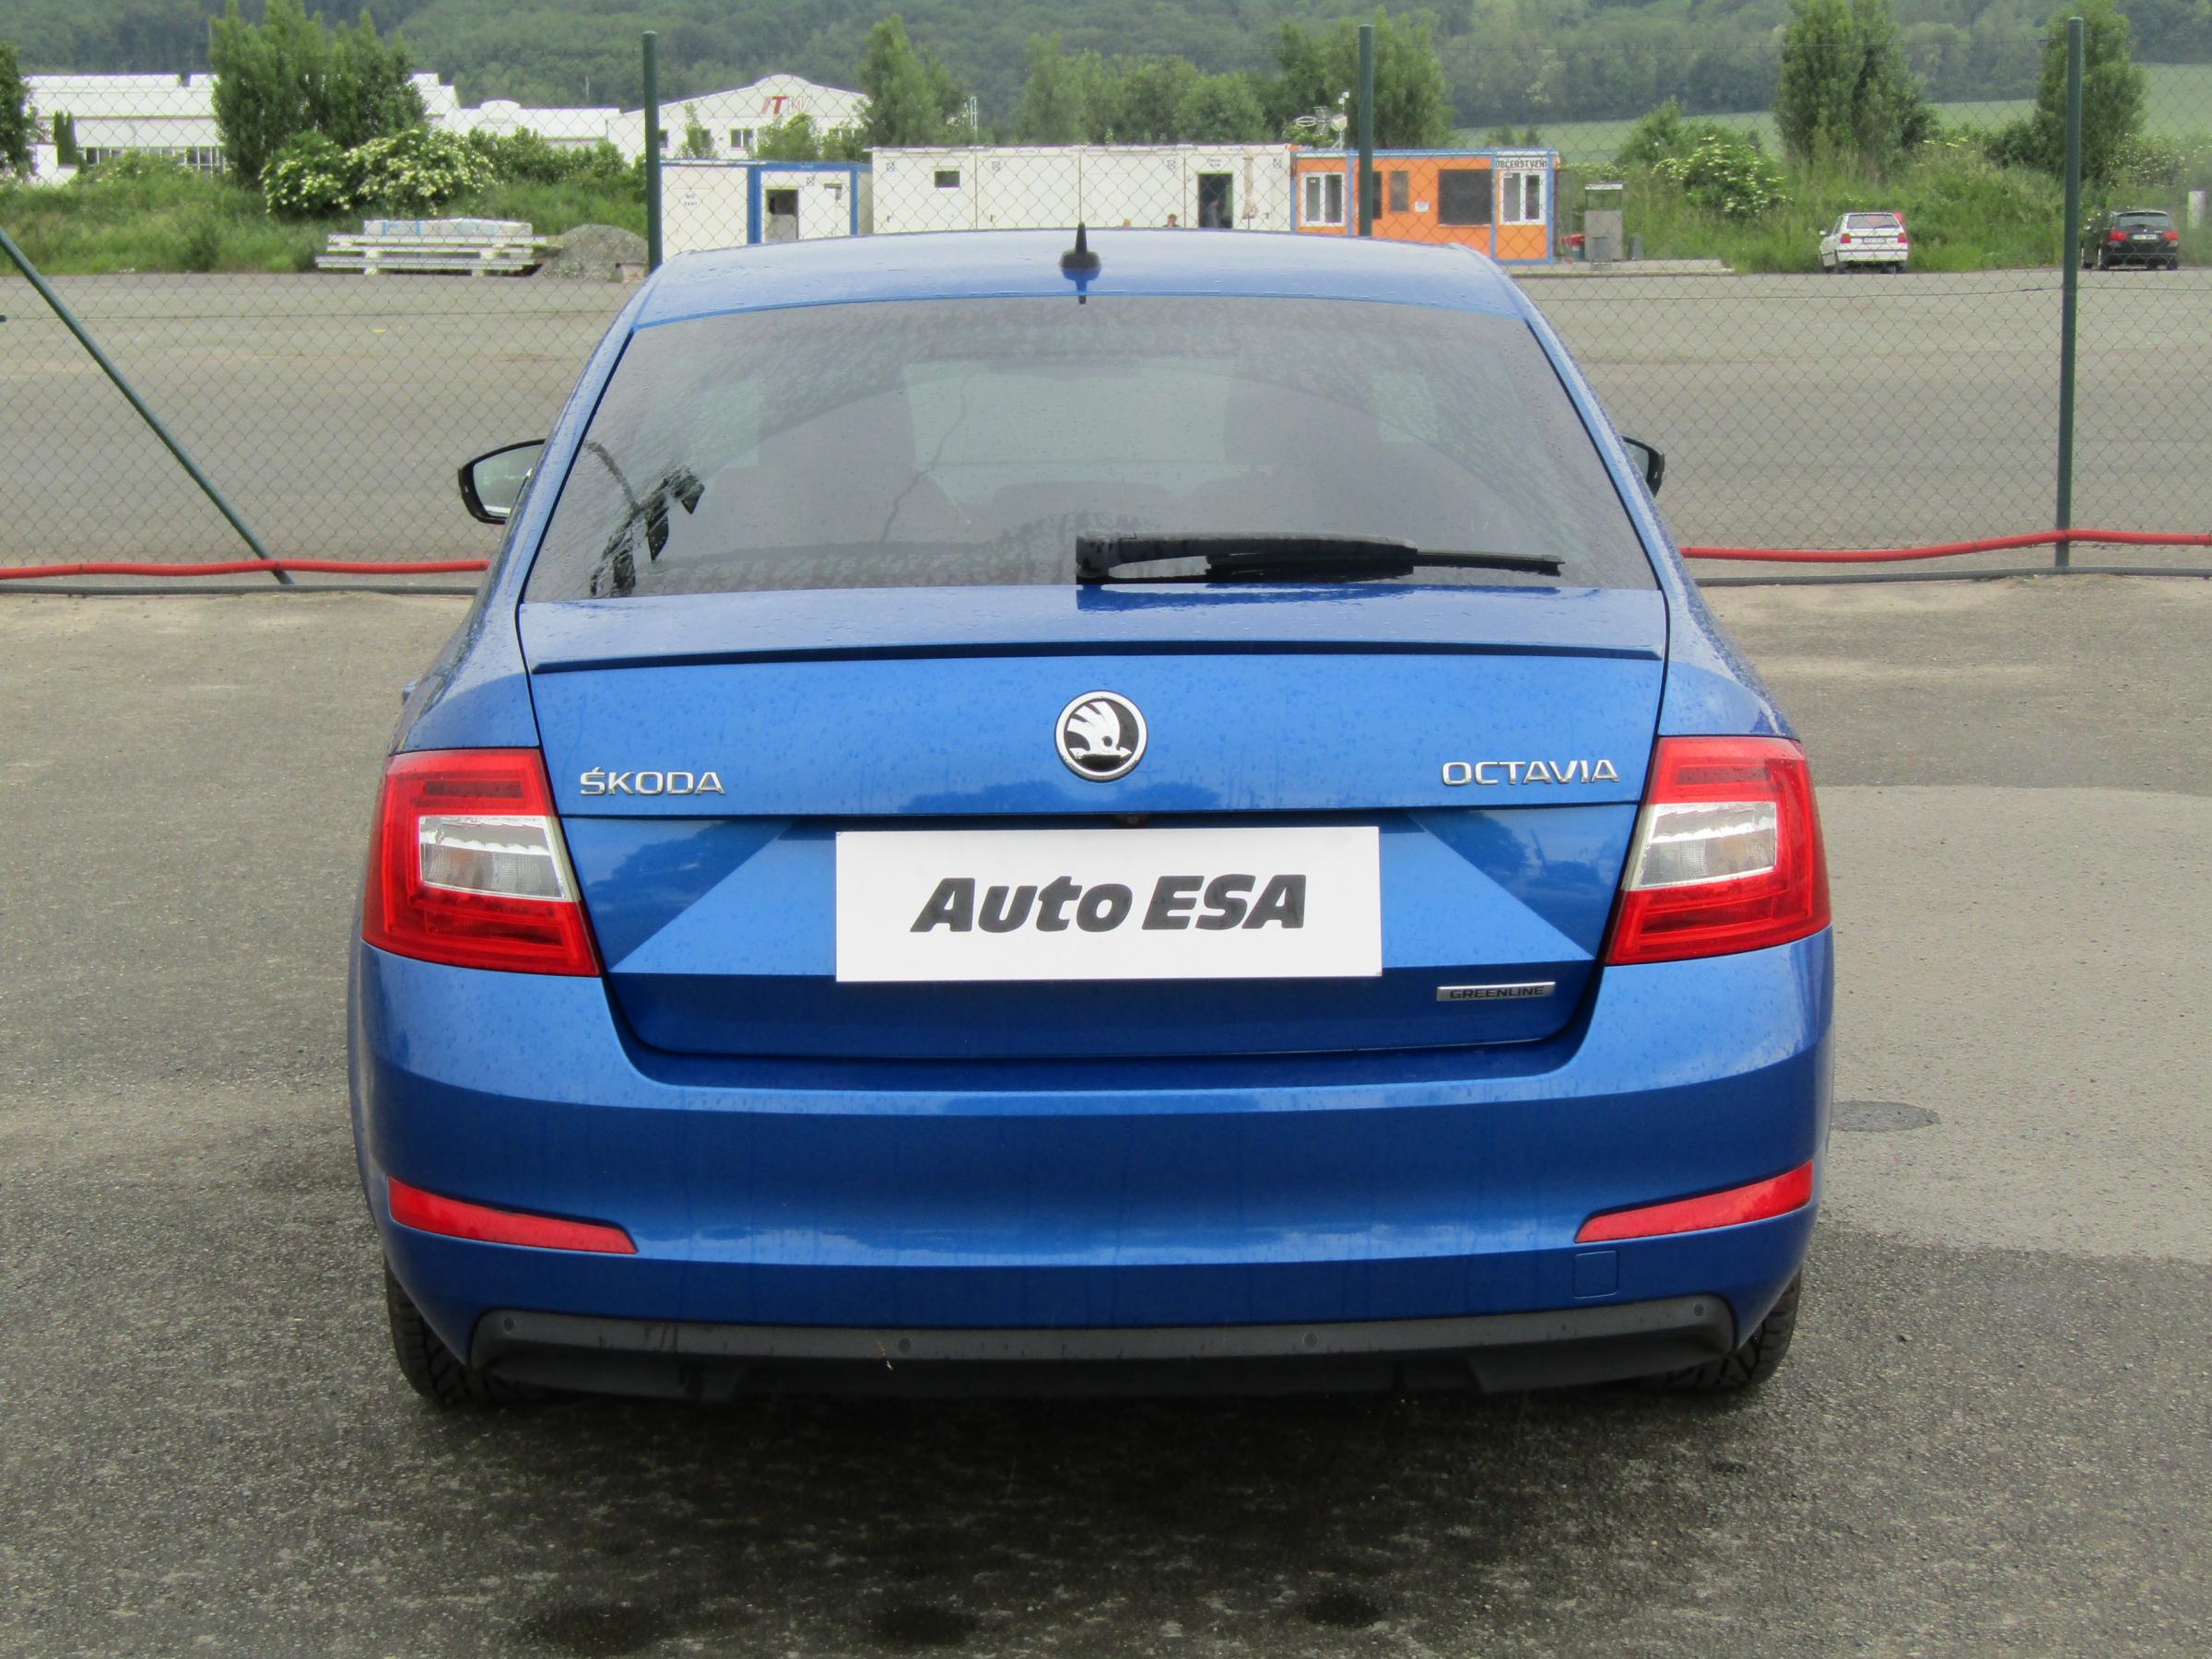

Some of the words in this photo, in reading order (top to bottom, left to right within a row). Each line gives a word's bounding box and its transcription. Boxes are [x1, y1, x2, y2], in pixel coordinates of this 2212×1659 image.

[759, 95, 813, 115] ITW
[1441, 759, 1619, 785] OCTAVIA
[910, 876, 1133, 934] Auto
[1141, 874, 1307, 931] ESA
[1450, 986, 1545, 999] GREENLINE
